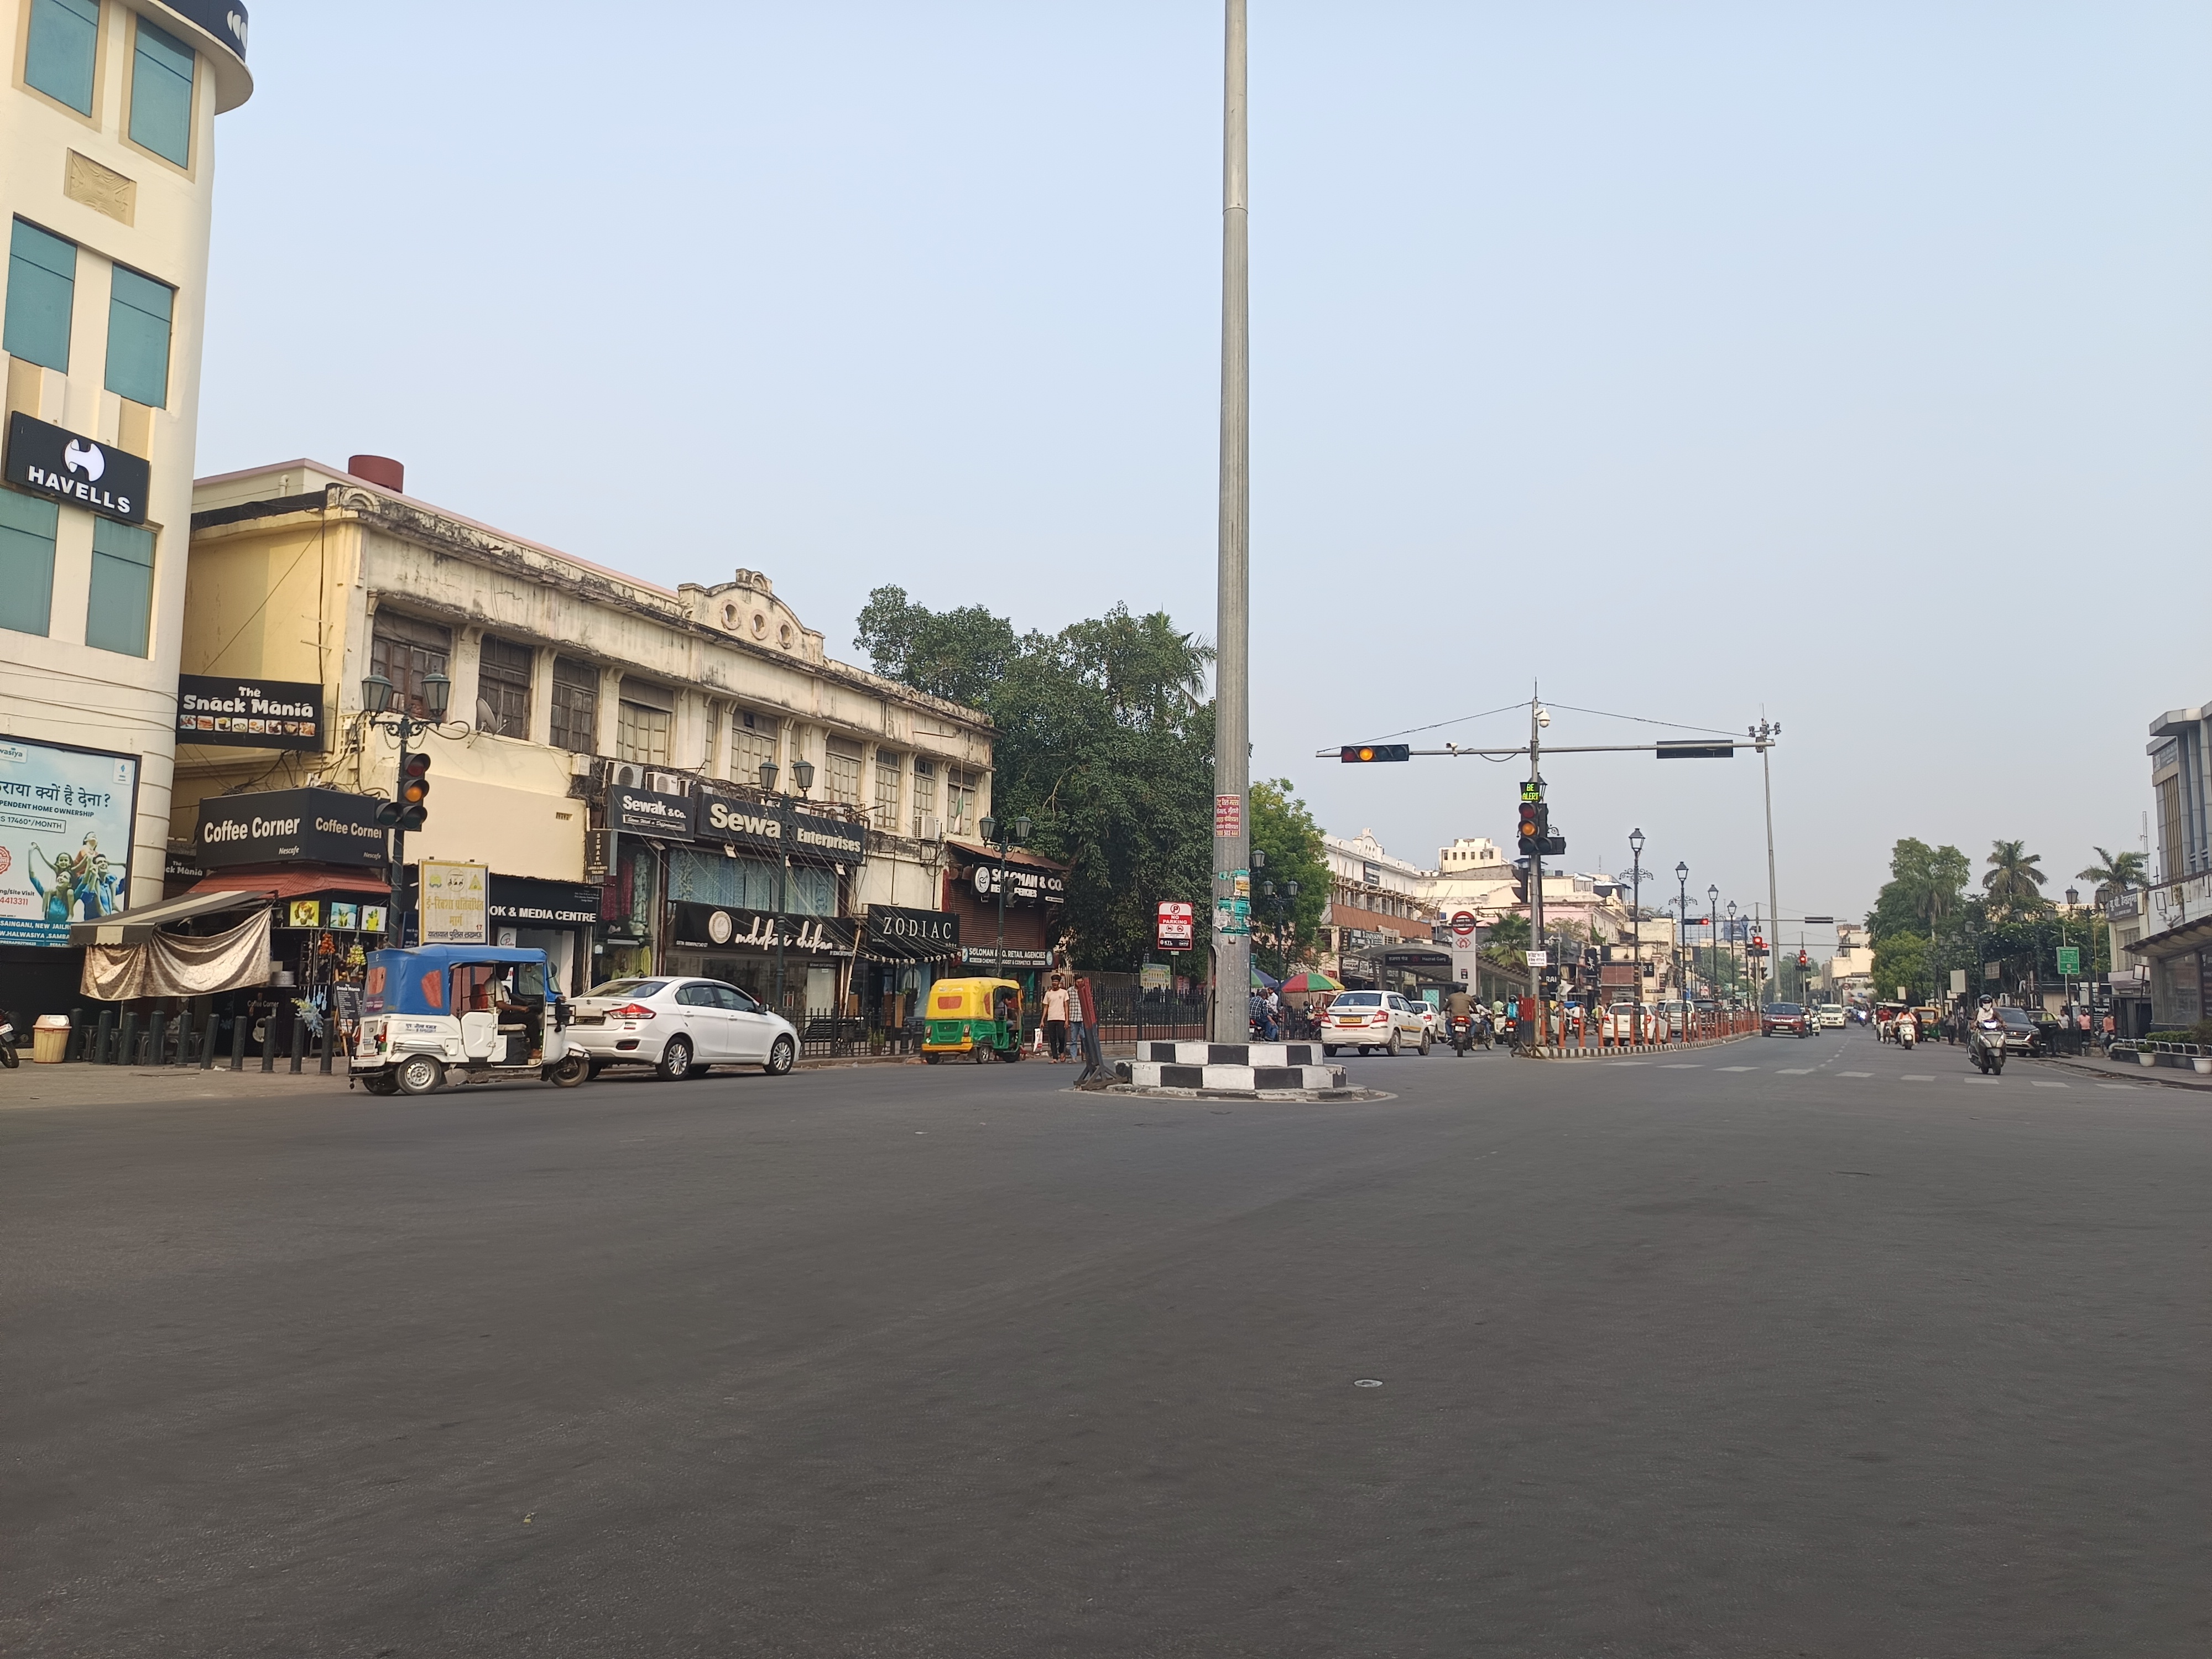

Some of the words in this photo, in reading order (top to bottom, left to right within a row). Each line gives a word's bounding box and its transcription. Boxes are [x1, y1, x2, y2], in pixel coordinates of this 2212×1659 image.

[28, 465, 131, 513] HAVELLS
[238, 686, 262, 697] The
[183, 695, 247, 713] Snack
[251, 699, 314, 718] Mania
[35, 783, 61, 801] क्यों
[64, 785, 74, 806] है
[33, 804, 53, 812] HOME
[54, 807, 95, 817] OWNERSHIP
[623, 795, 666, 816] Sewak
[204, 820, 248, 843] Coffee
[252, 817, 300, 838] Corner
[316, 817, 348, 835] Coffee
[709, 804, 781, 838] Sewa
[797, 827, 861, 853] Enterprises
[279, 846, 300, 855] Nescafe
[177, 867, 203, 876] Mania
[1039, 877, 1047, 889] &
[1047, 878, 1064, 891] CO.
[489, 905, 507, 916] OK
[508, 907, 517, 917] &
[519, 907, 554, 919] MEDIA
[555, 911, 596, 922] CENTRE
[883, 916, 951, 939] ZODIAC
